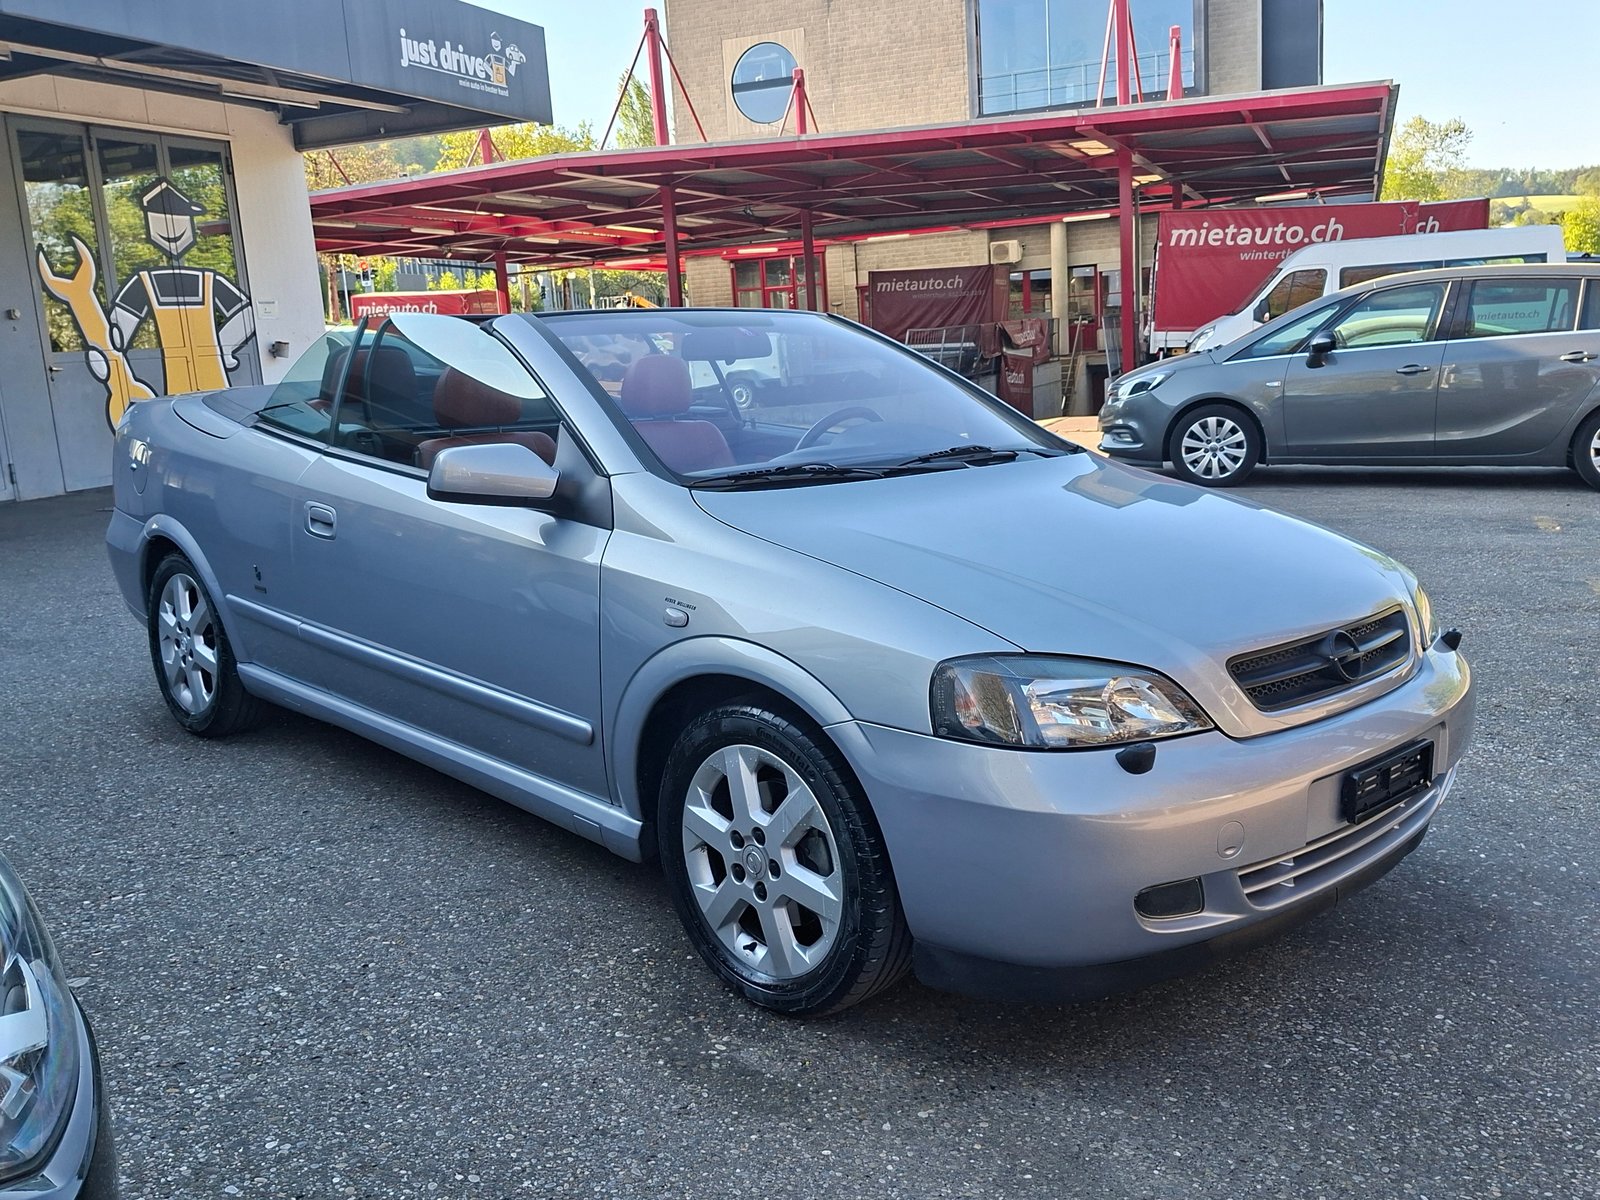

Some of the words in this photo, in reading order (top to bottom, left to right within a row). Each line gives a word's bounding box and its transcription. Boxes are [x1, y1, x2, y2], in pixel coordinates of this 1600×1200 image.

[400, 28, 438, 67] just
[440, 41, 486, 78] drive
[1170, 217, 1344, 246] mietauto.ch
[876, 275, 963, 292] mietauto.ch
[1477, 309, 1540, 321] mietauto.ch
